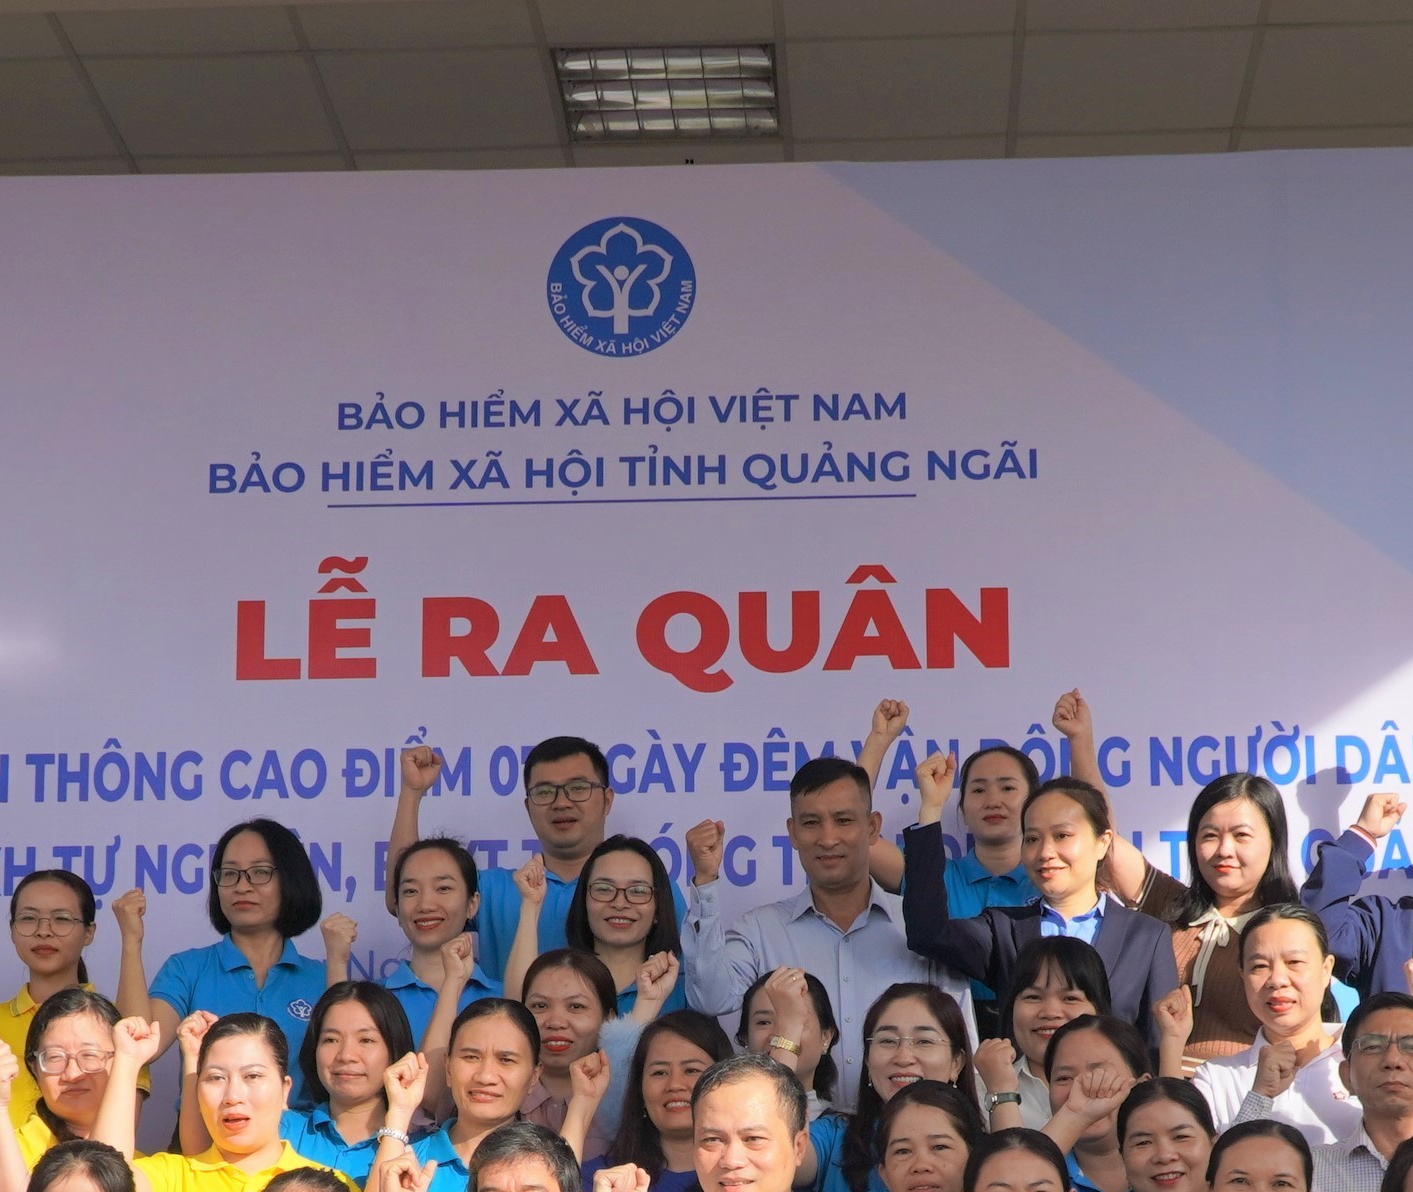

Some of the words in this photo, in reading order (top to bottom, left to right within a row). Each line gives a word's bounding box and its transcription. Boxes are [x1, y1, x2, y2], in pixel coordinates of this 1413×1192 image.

[550, 282, 568, 314] BẢO
[560, 315, 594, 347] HIỂM
[596, 340, 616, 354] XÃ
[622, 338, 649, 354] HỘI
[650, 315, 681, 343] VIỆT
[676, 280, 692, 313] NAM
[337, 392, 425, 430] BẢO
[439, 389, 541, 428] HIỂM
[555, 391, 610, 427] XÃ
[623, 389, 696, 432] HỘI
[708, 388, 799, 431] VIỆT
[812, 392, 907, 421] NAM
[208, 451, 305, 493] BẢO
[321, 448, 434, 492] HIỂM
[449, 450, 510, 490] XÃ
[525, 449, 604, 496] HỘI
[618, 444, 726, 486] TỈNH
[742, 441, 910, 490] QUẢNG
[927, 440, 1038, 481] NGÃI
[235, 556, 377, 680] LỄ
[421, 594, 600, 677] RA
[636, 564, 1010, 693] QUÂN
[25, 737, 203, 803] THÔNG
[219, 747, 328, 799] CAO
[489, 745, 534, 796] 0
[605, 729, 707, 794] GÀY
[1149, 720, 1316, 786] NGƯỜI
[52, 834, 121, 910] TỰ
[135, 827, 357, 903] NGN,
[648, 822, 757, 887] ÓG
